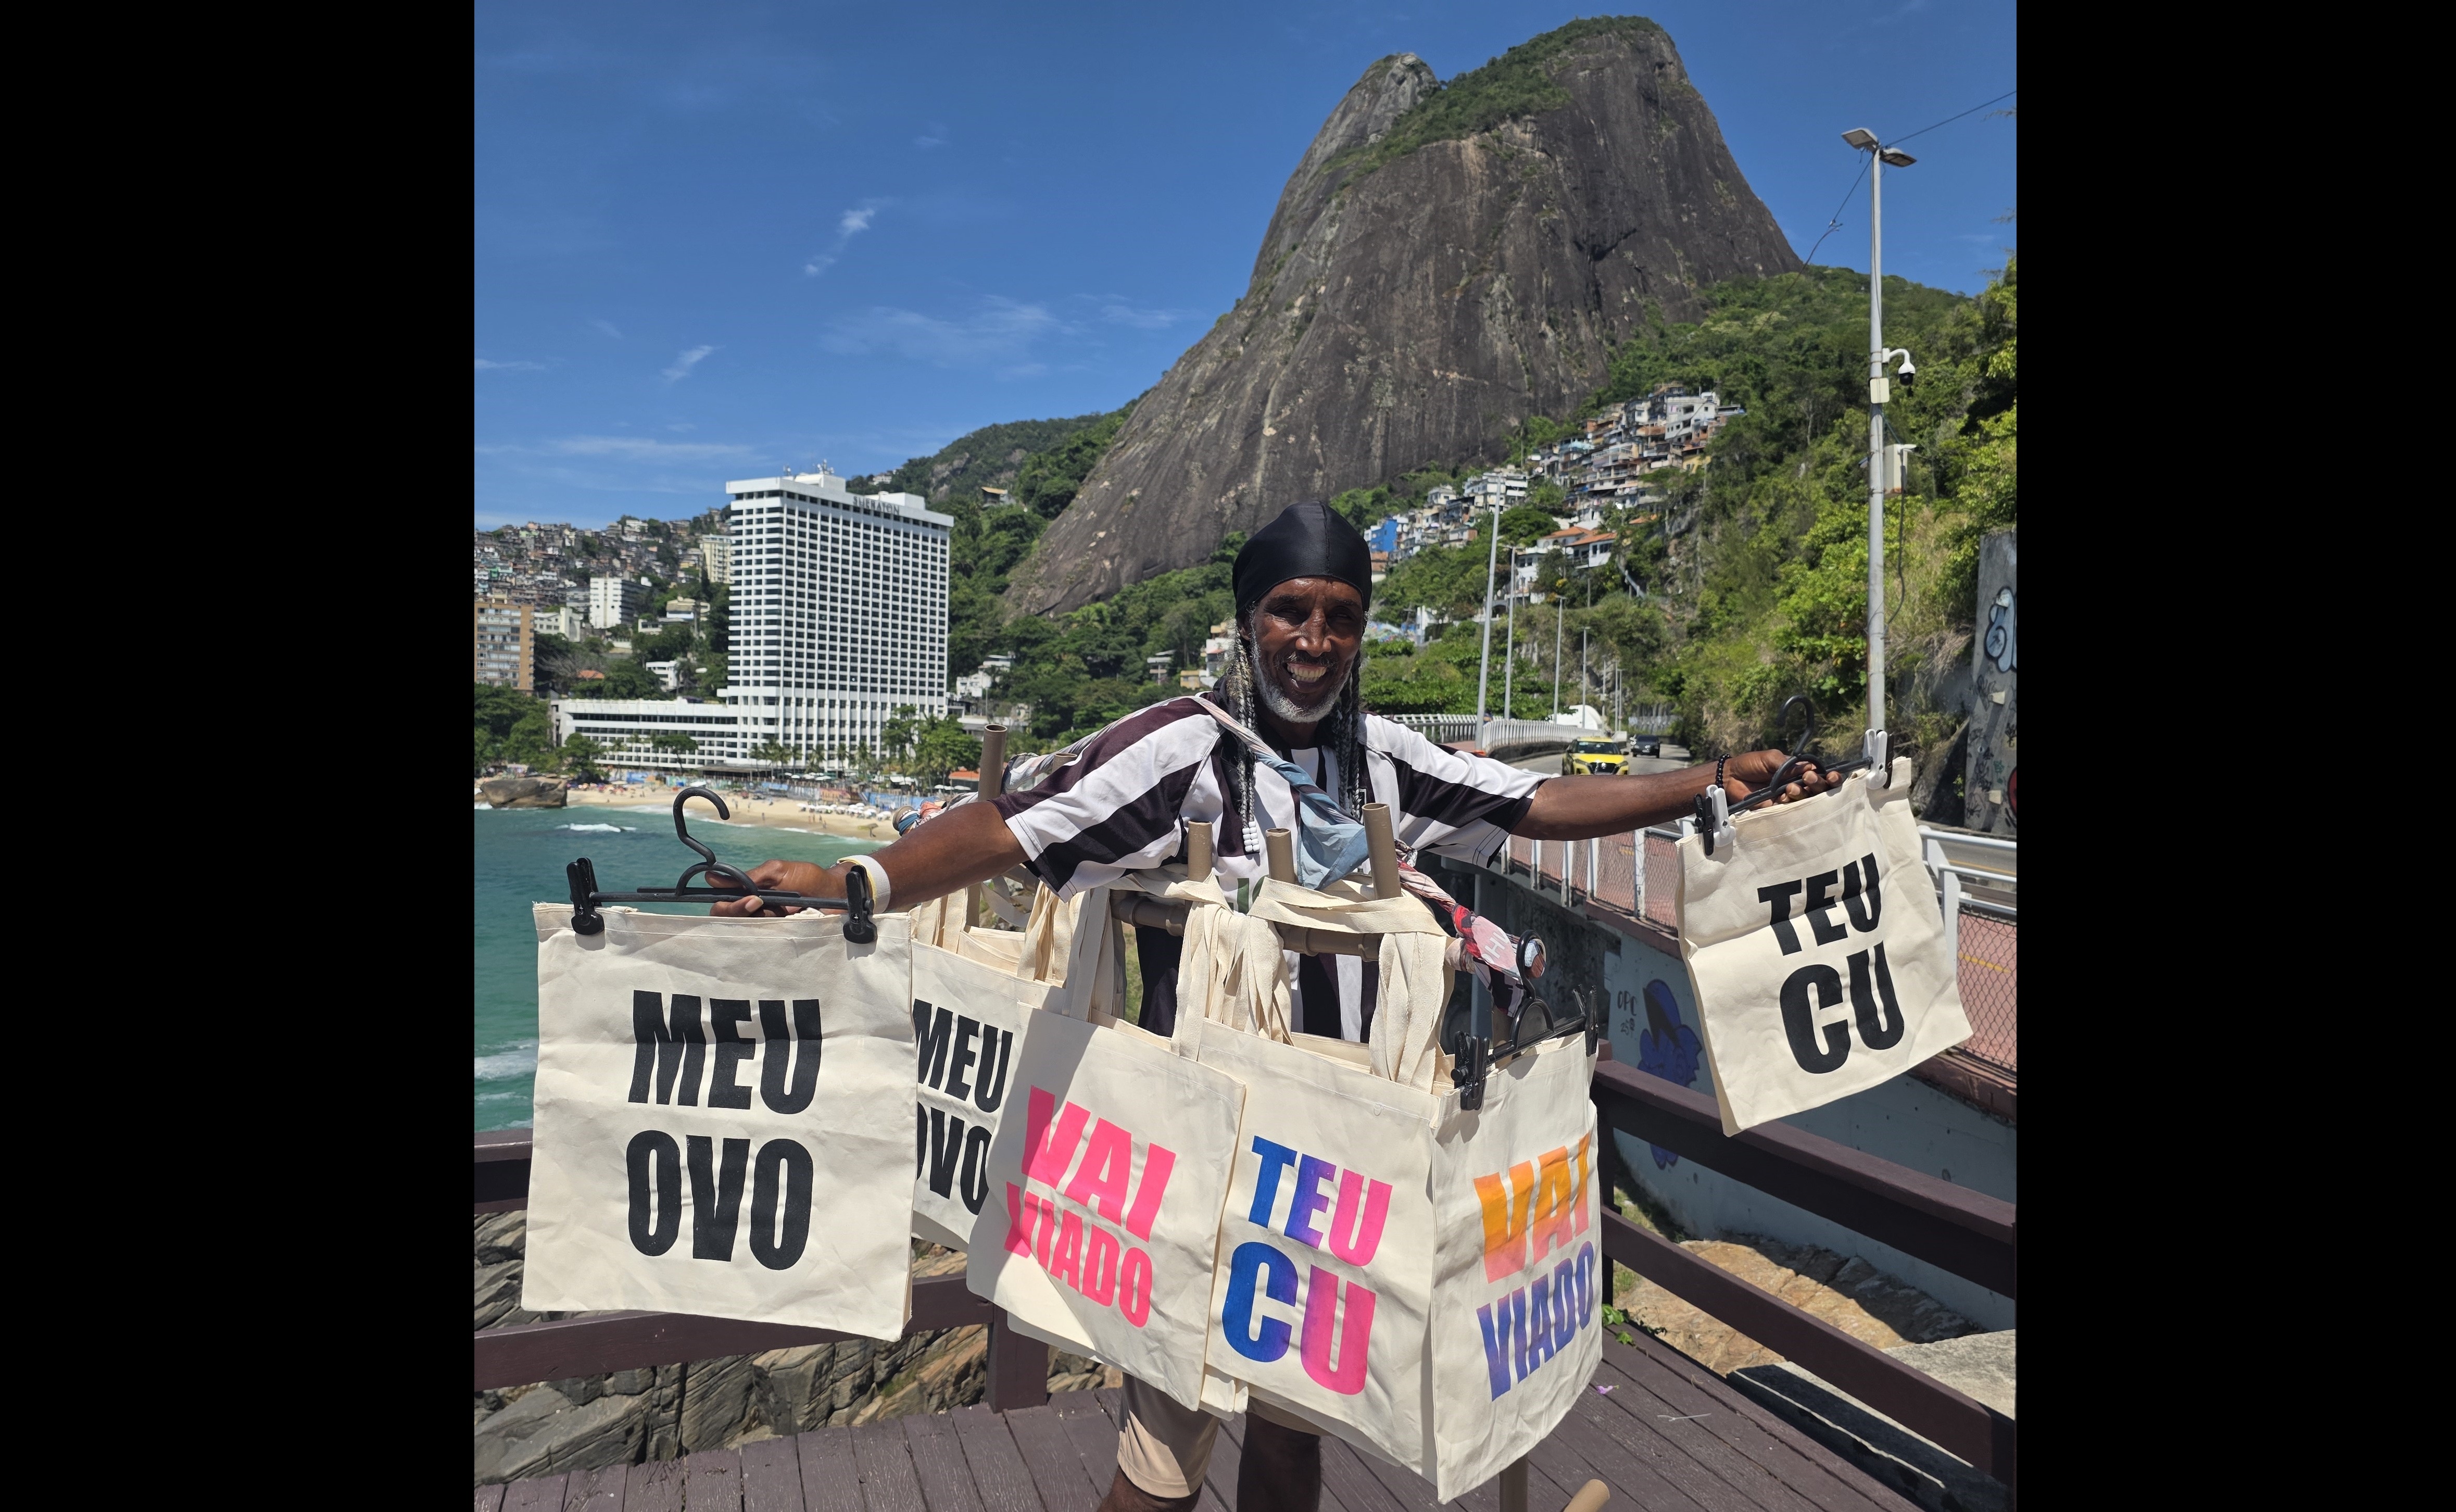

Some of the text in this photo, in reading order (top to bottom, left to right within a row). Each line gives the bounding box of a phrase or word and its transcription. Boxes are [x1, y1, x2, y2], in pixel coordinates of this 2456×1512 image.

[853, 496, 900, 515] SHERATON
[1757, 852, 1882, 956] TEU
[627, 989, 823, 1115] MEU
[912, 998, 1014, 1114] MEU
[1779, 940, 1905, 1074] CU
[626, 1129, 814, 1271] OVO
[1021, 1084, 1177, 1243] VAI
[1248, 1135, 1393, 1267] TEU
[1473, 1131, 1591, 1284] VAI
[1004, 1181, 1153, 1329] VIADO
[1221, 1241, 1377, 1396] CU
[1476, 1240, 1594, 1402] VIADO
